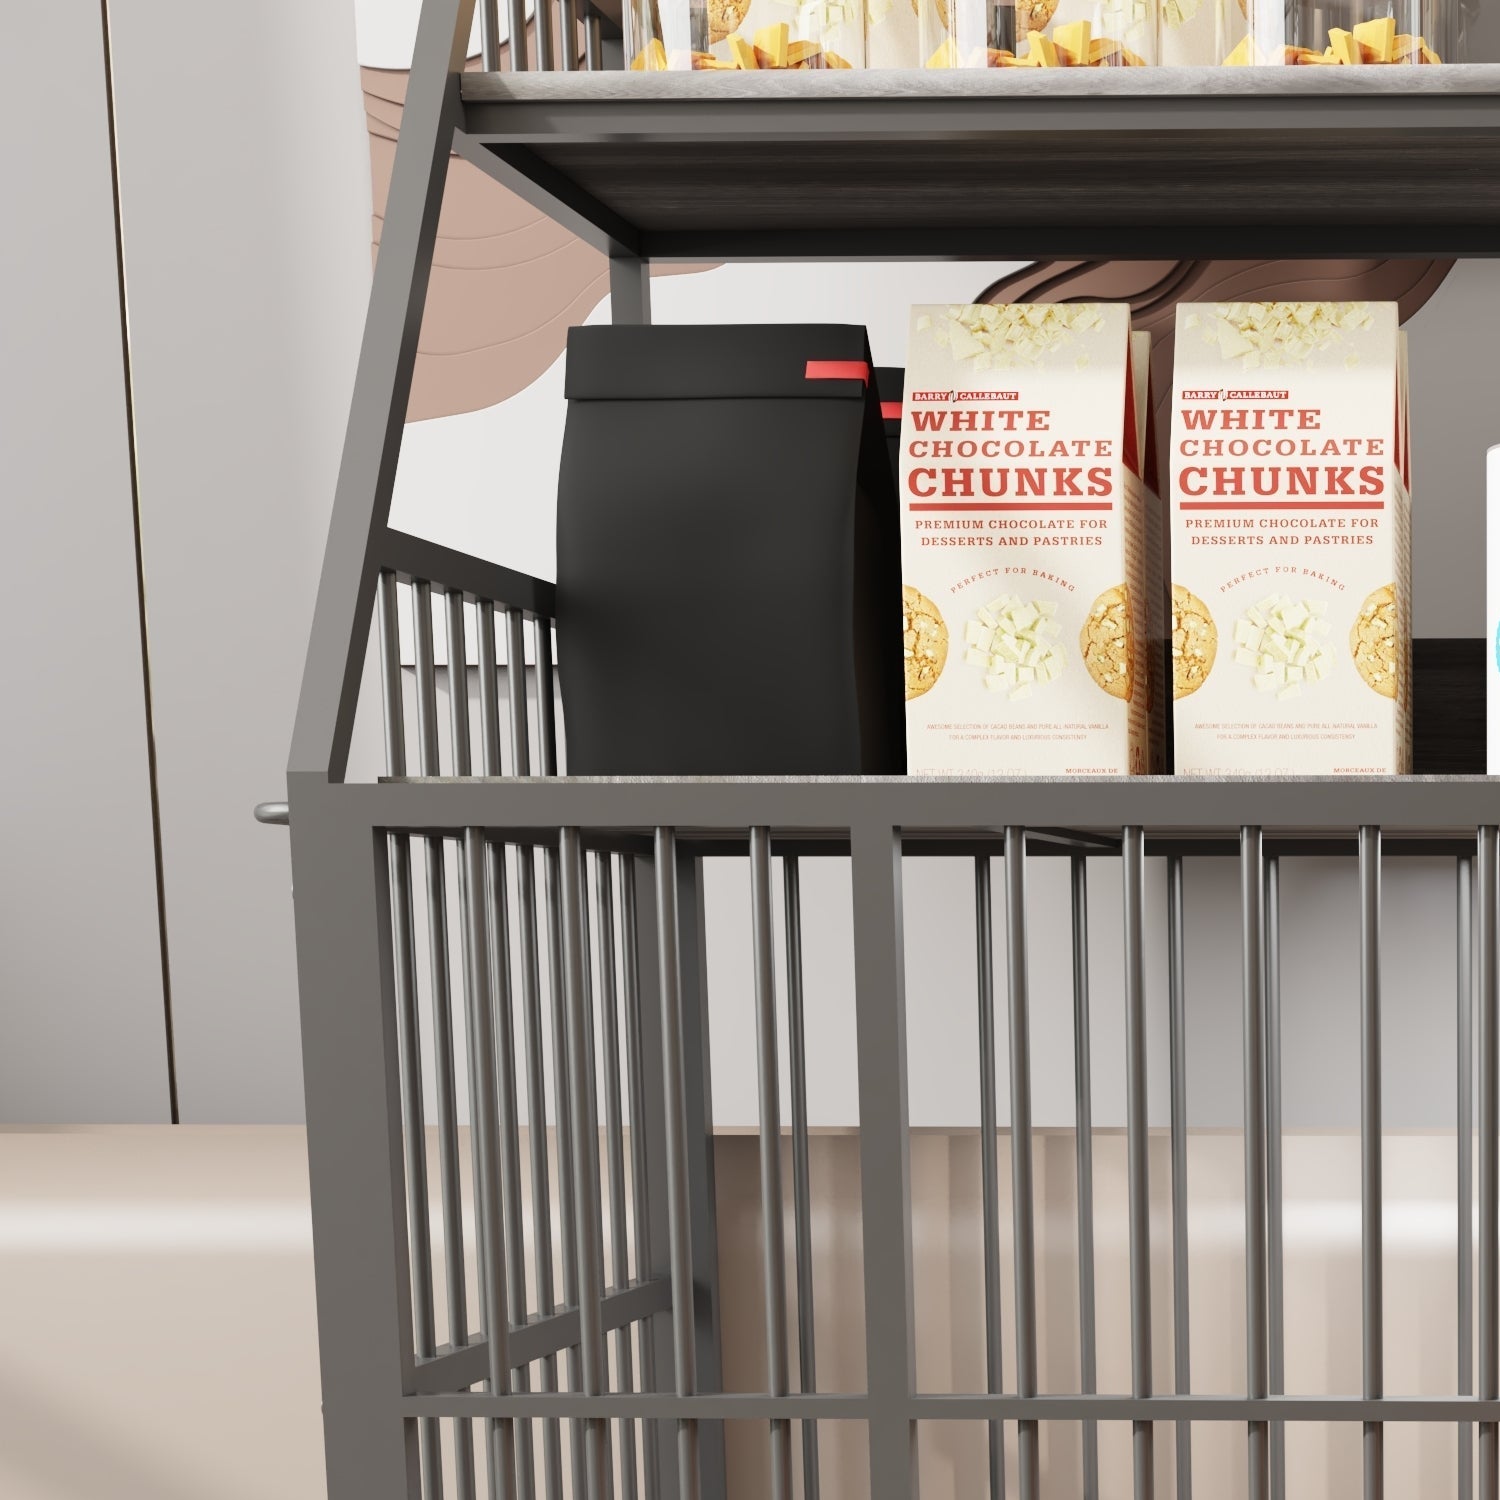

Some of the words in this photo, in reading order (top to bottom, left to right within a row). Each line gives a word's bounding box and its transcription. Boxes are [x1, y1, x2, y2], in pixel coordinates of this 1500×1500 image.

[1184, 391, 1217, 399] BARRY
[1229, 391, 1287, 399] CALLEBAUT
[911, 411, 1050, 431] WHITE
[1181, 409, 1321, 430] WHITE
[909, 440, 1112, 457] CHOCOLATE
[1179, 439, 1384, 457] CHOCOLATE
[908, 467, 1113, 497] CHUNKS
[1179, 466, 1385, 496] CHUNKS
[915, 519, 983, 529] PREMIUM
[988, 519, 1075, 529] CHOCOLATE
[1080, 519, 1108, 529] FOR
[1185, 518, 1254, 528] PREMIUM
[1259, 518, 1346, 528] CHOCOLATE
[1351, 518, 1379, 528] FOR
[921, 537, 993, 546] DESSERTS
[998, 537, 1029, 546] AND
[1033, 537, 1102, 546] PASTRIES
[1191, 535, 1263, 545] DESSERTS
[1268, 535, 1299, 545] AND
[1304, 535, 1373, 545] PASTRIES
[950, 568, 999, 593] PERFECT
[1032, 569, 1076, 592] BAKING
[1220, 567, 1269, 593] PERFECT
[1303, 568, 1346, 591] BAKING
